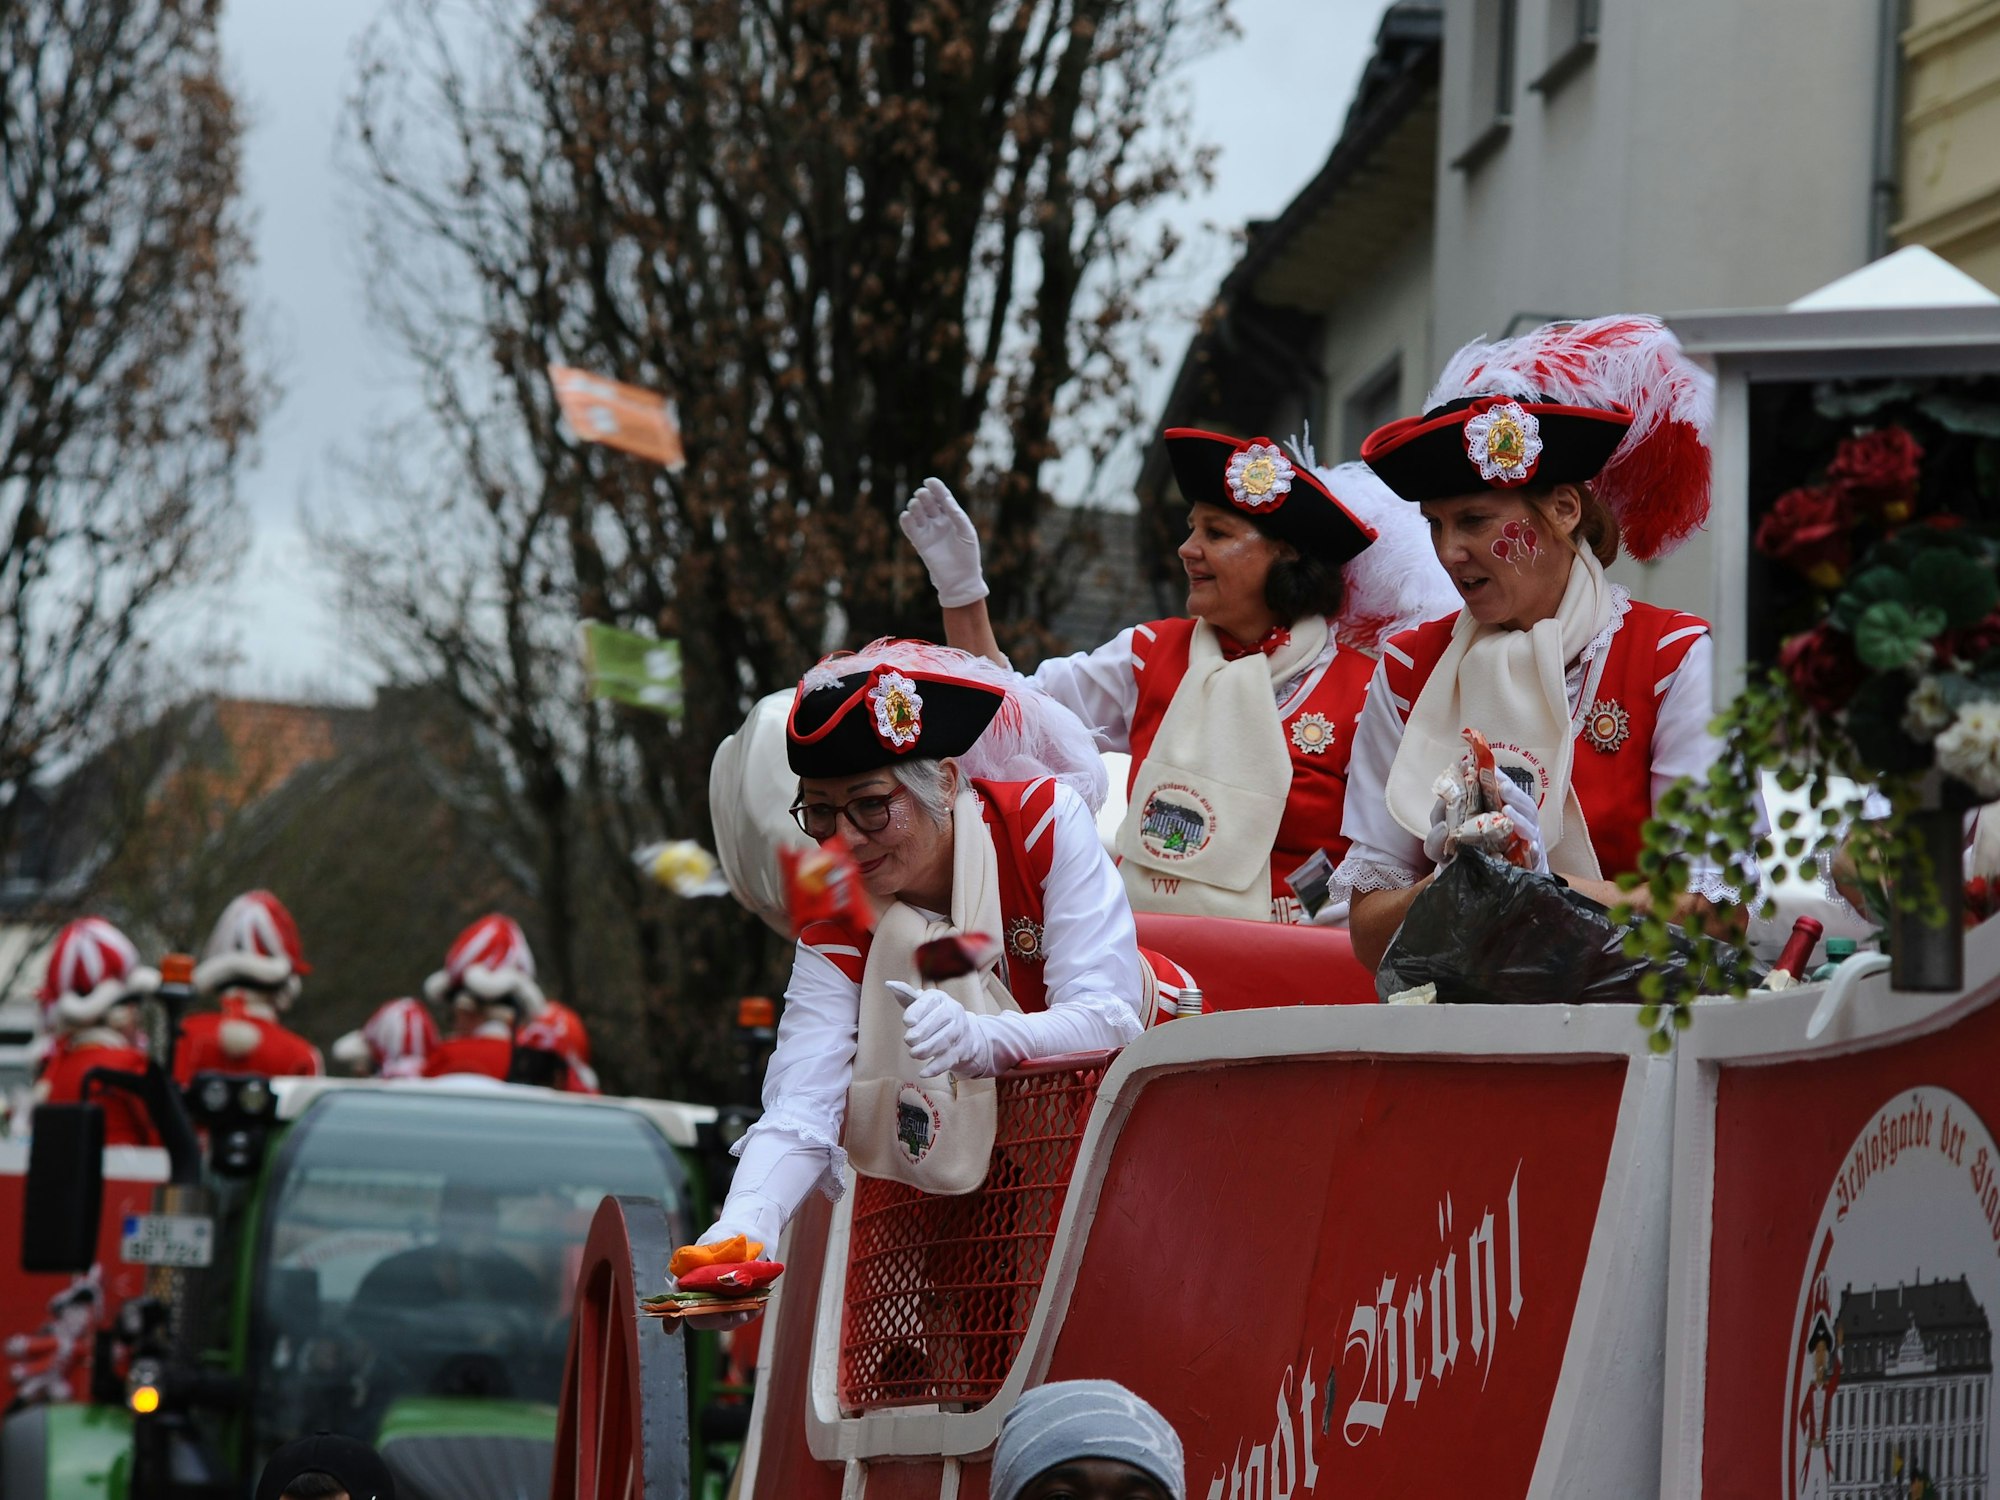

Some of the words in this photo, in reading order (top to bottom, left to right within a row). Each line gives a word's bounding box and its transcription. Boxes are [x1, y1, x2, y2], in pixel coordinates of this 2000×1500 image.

[1152, 878, 1181, 895] VW
[1941, 1104, 1966, 1166] der
[1970, 1146, 2000, 1258] Stad
[1343, 1157, 1523, 1446] Brühl
